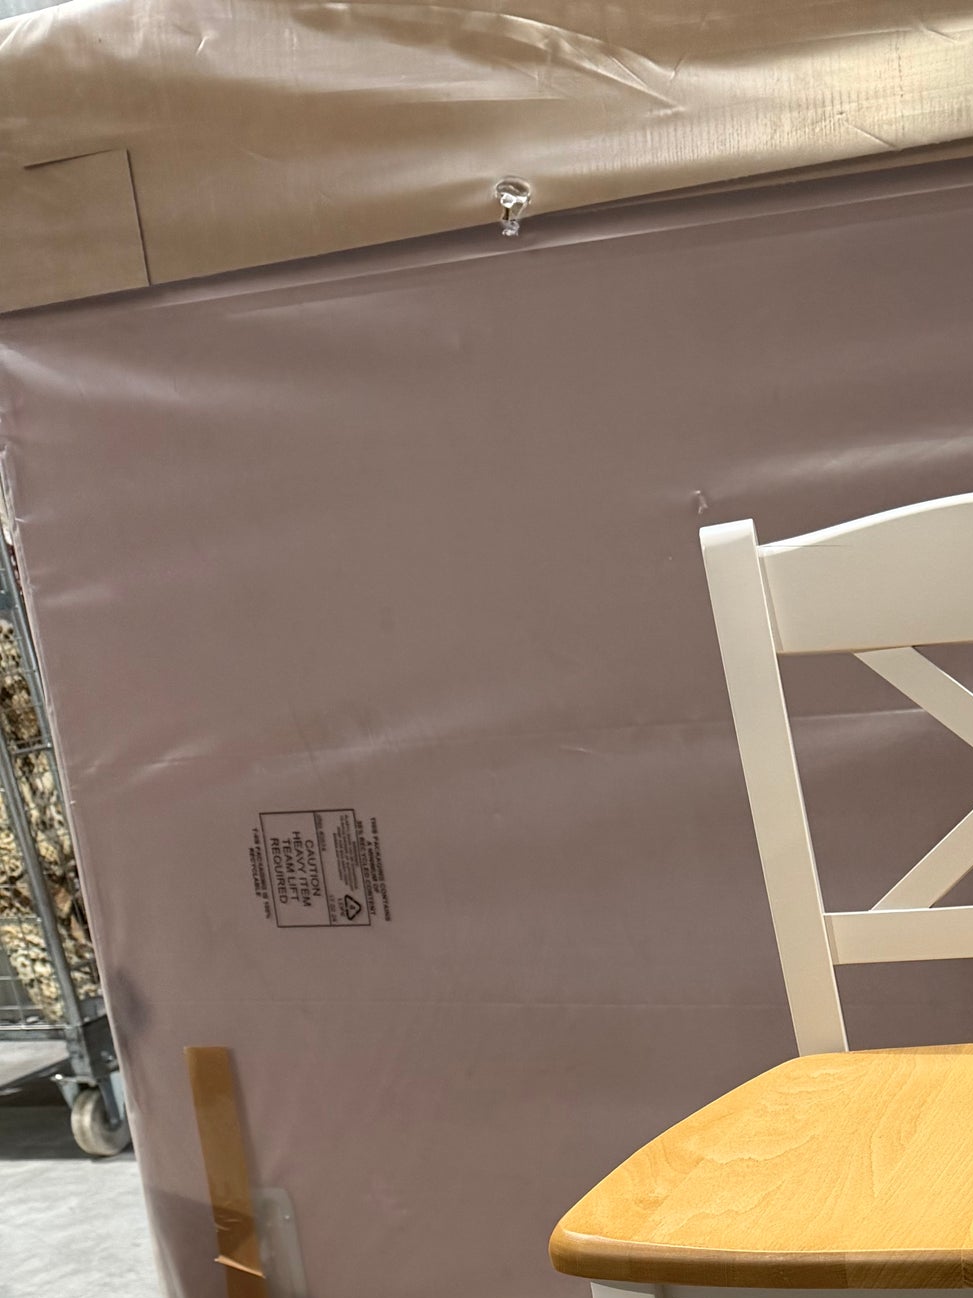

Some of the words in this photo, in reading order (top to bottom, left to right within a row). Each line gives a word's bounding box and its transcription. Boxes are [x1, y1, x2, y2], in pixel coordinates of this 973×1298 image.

[249, 848, 262, 897] RECYCLABLE
[270, 838, 288, 904] REQUIRED
[282, 838, 295, 873] TEAM
[292, 831, 306, 873] HEAVY
[299, 877, 312, 907] ITEM
[305, 840, 321, 897] CAUTION
[359, 837, 370, 878] RECYCLED
[366, 880, 376, 915] CONTENT
[373, 836, 384, 881] PACKAGING
[380, 883, 390, 921] CONTAINS
[288, 877, 300, 901] LIFT
